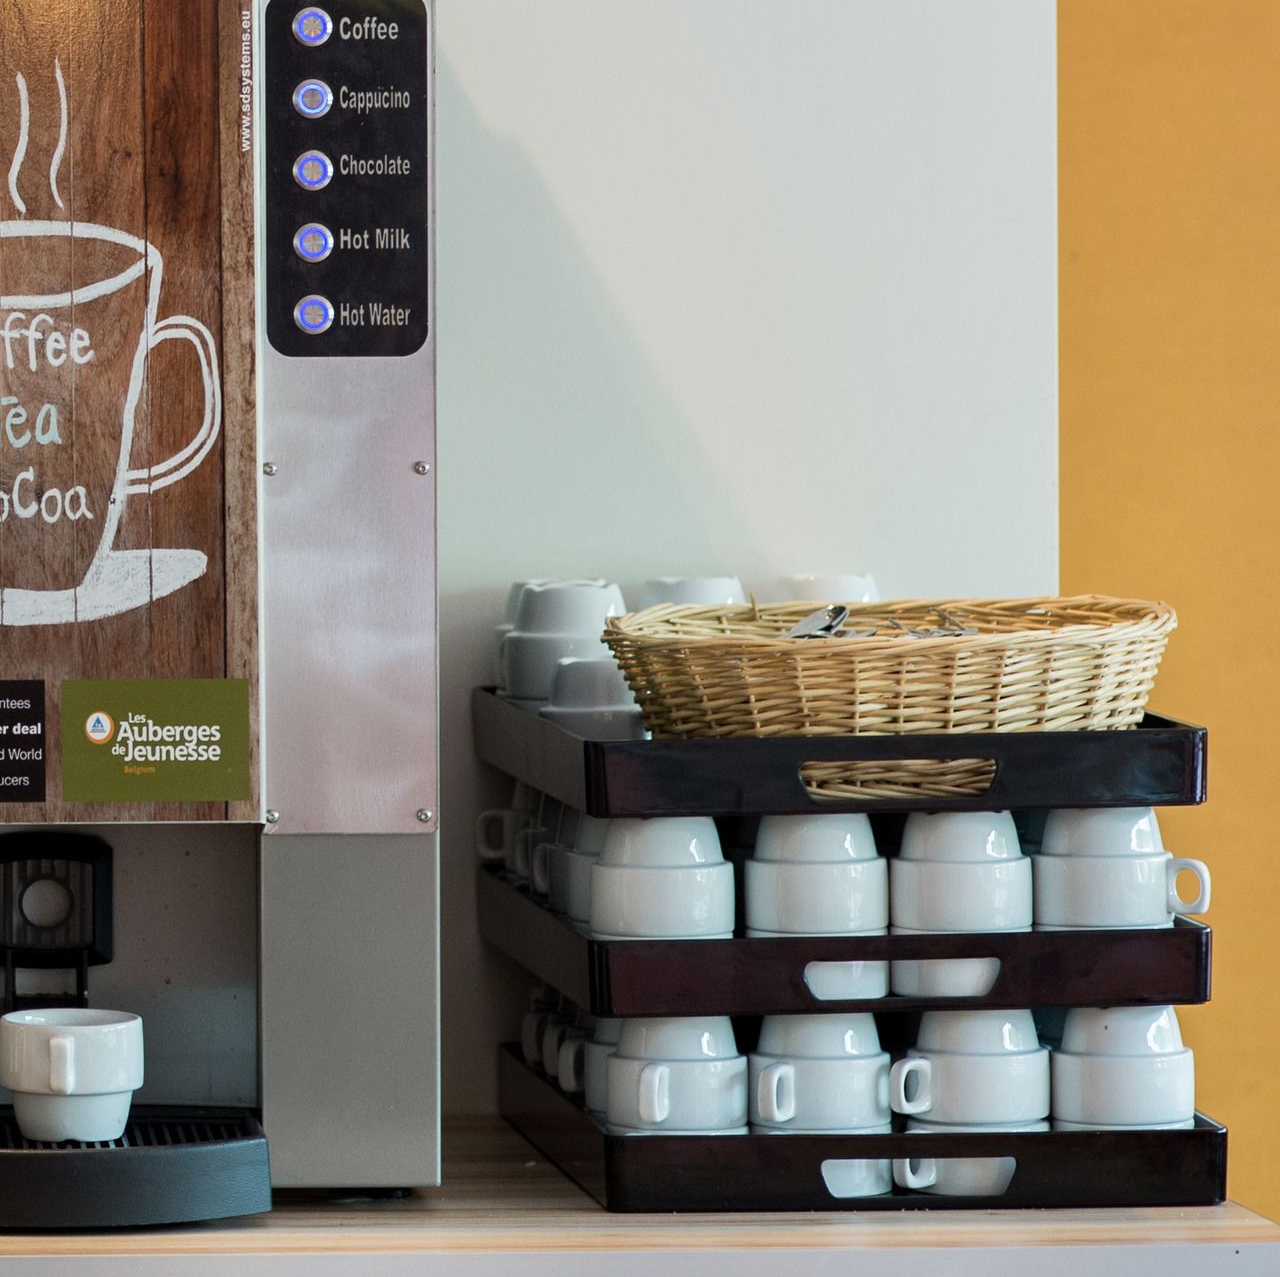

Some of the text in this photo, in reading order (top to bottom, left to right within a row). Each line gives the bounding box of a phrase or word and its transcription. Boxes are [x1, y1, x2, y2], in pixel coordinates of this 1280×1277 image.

[340, 17, 399, 41] Coffee
[241, 10, 252, 153] www.sdsystems.eu
[340, 154, 411, 176] Chocolate
[340, 228, 411, 250] Hot Milk
[340, 303, 411, 327] Hot Water
[12, 722, 42, 735] deal
[128, 712, 147, 724] Les
[116, 719, 222, 748] Auberges
[8, 748, 43, 761] World
[111, 740, 222, 762] de Jeunesse
